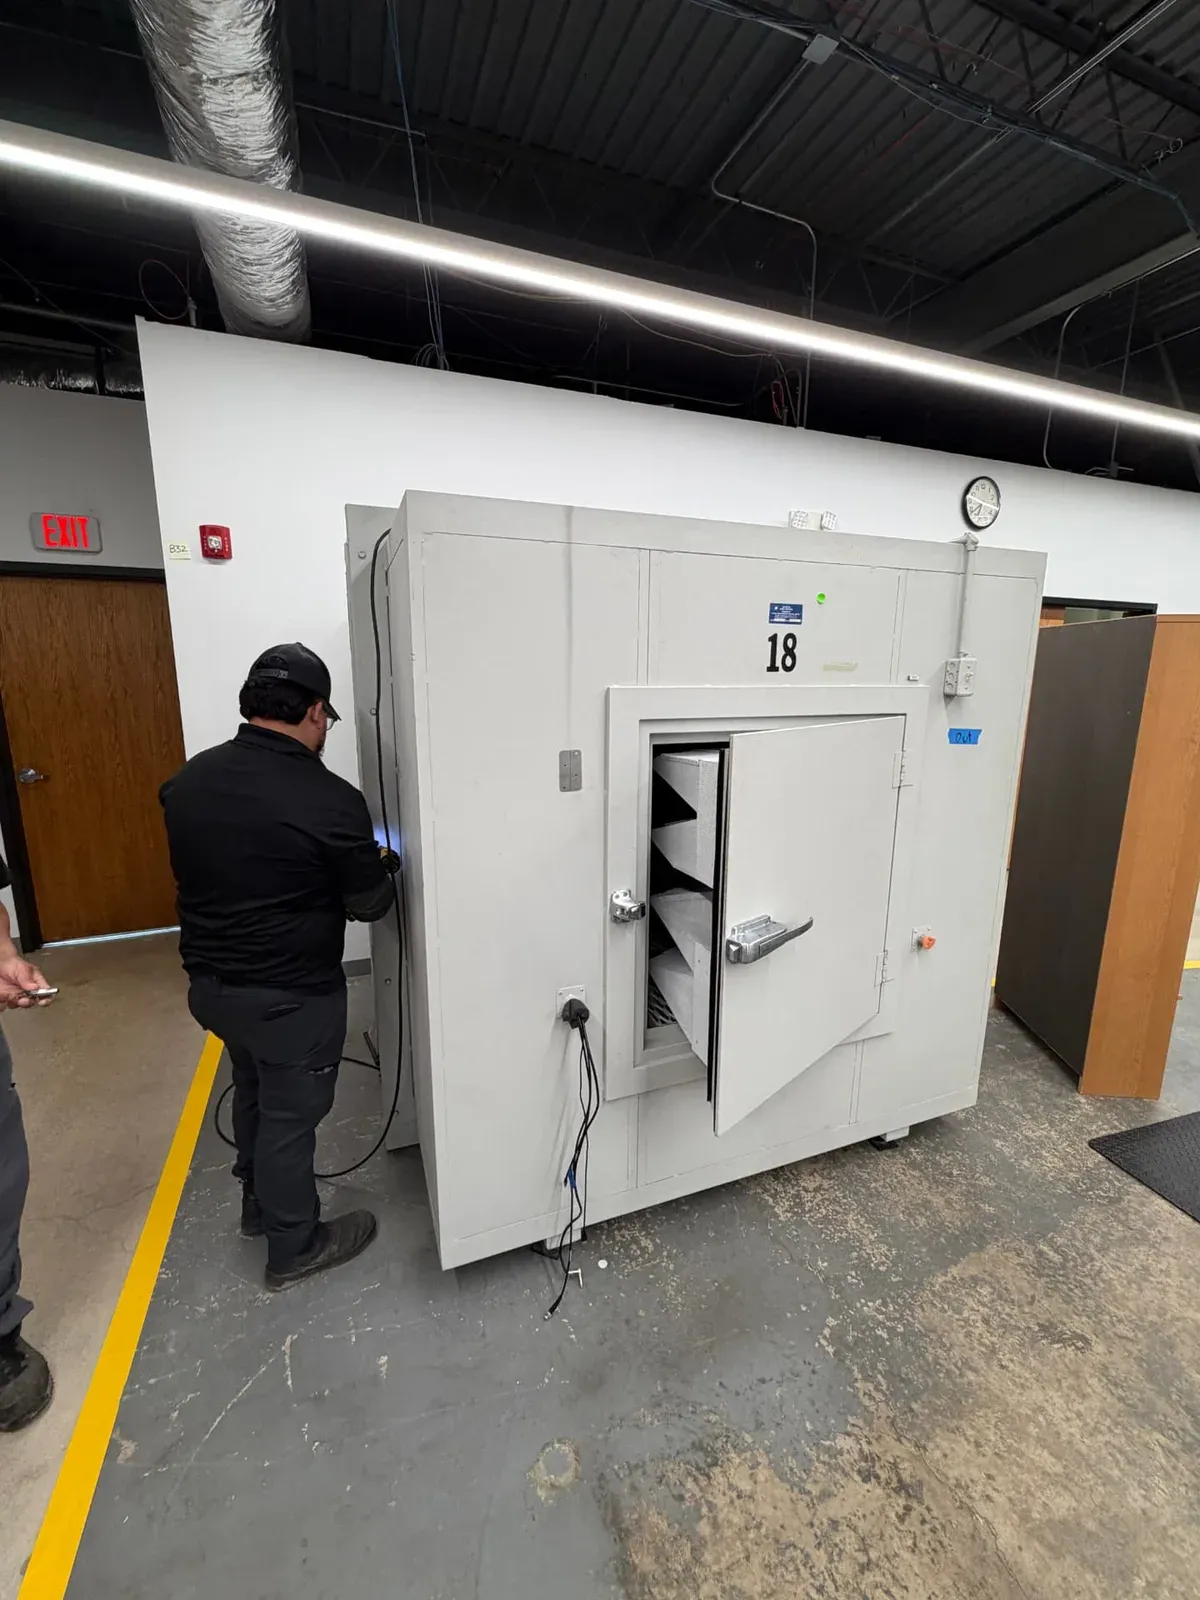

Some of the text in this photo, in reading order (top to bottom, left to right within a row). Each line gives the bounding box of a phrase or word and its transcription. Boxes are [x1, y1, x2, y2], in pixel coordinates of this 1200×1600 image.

[42, 515, 89, 549] EXIT
[169, 544, 188, 553] B32
[767, 632, 797, 673] 18
